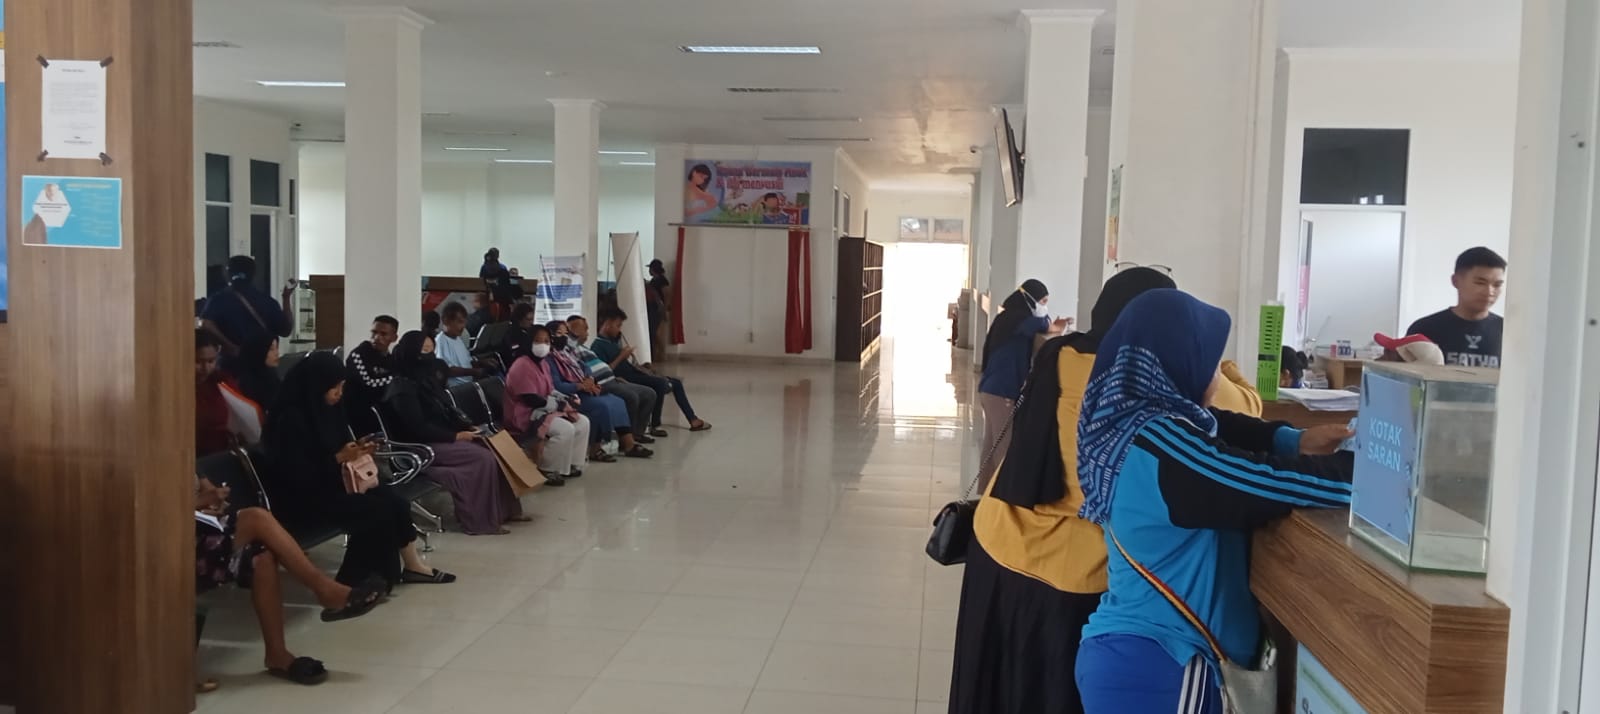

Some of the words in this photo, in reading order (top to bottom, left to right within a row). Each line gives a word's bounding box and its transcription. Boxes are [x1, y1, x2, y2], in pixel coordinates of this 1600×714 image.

[1447, 352, 1499, 368] SATYA
[1369, 418, 1402, 446] KOTAK
[1367, 442, 1401, 472] SARAN
